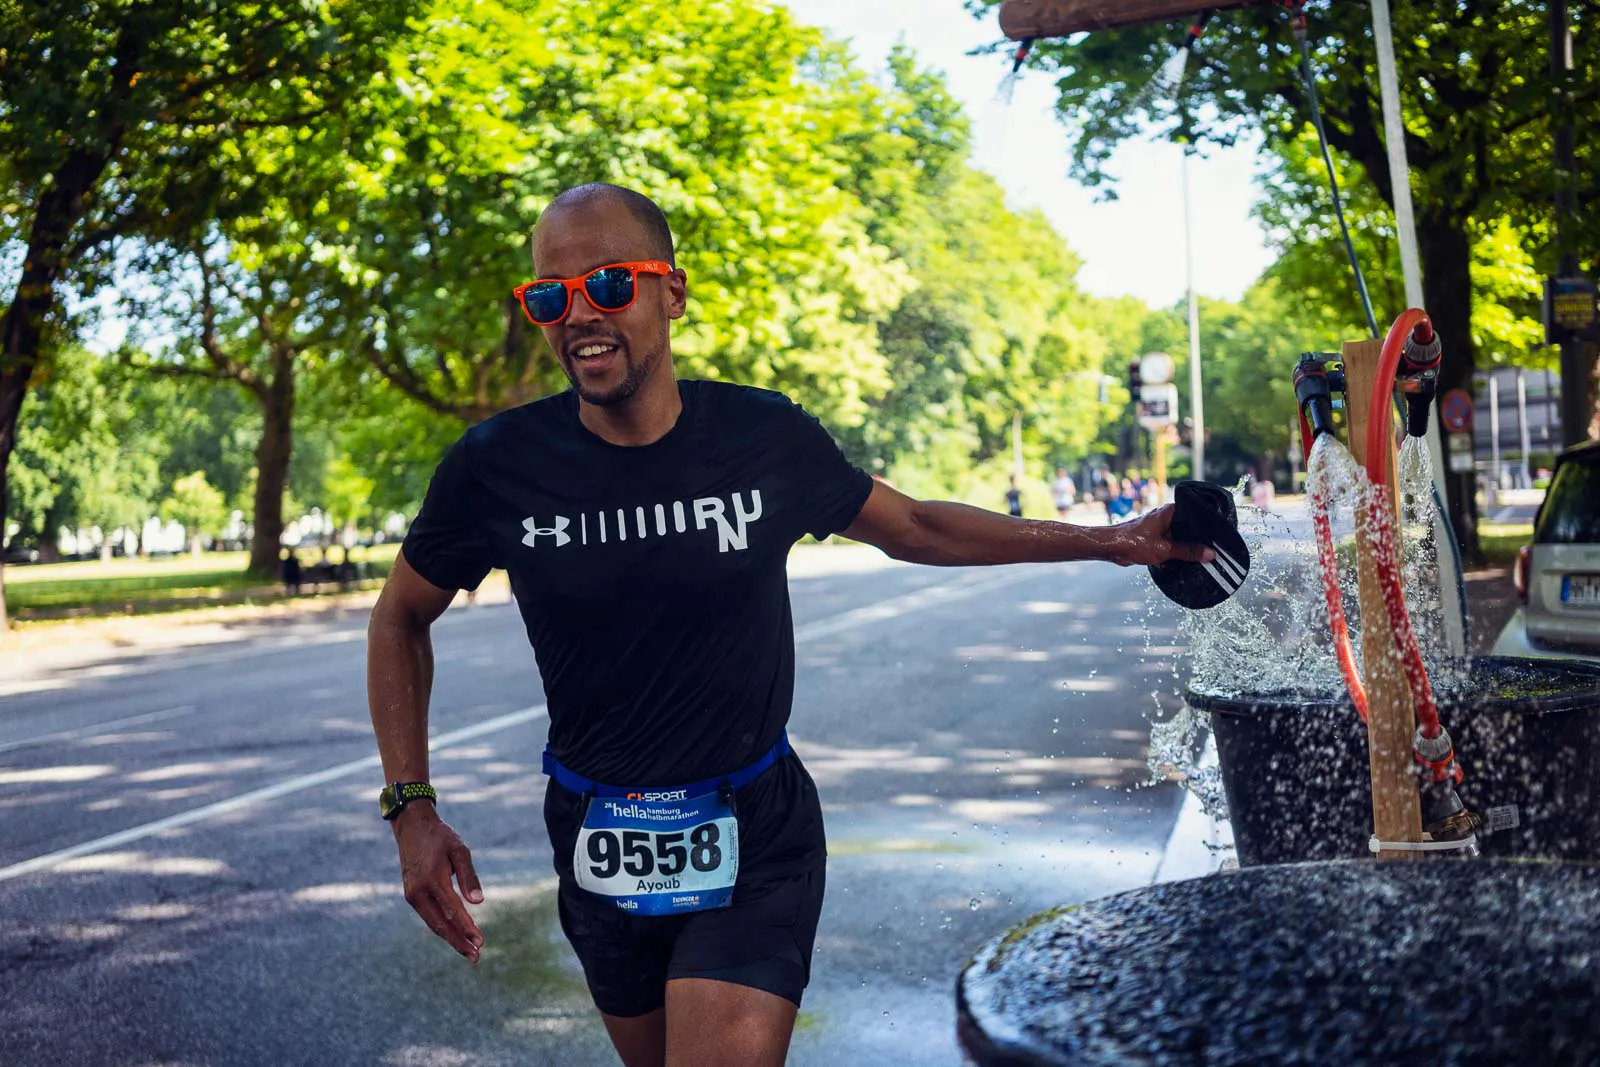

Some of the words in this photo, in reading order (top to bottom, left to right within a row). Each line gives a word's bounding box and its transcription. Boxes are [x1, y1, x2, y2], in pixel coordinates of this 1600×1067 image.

[613, 802, 647, 819] hella
[646, 807, 680, 815] hamburg
[647, 810, 699, 821] halbmarathon
[587, 822, 722, 878] 9558
[636, 878, 681, 893] Ayoub
[616, 900, 639, 909] hella
